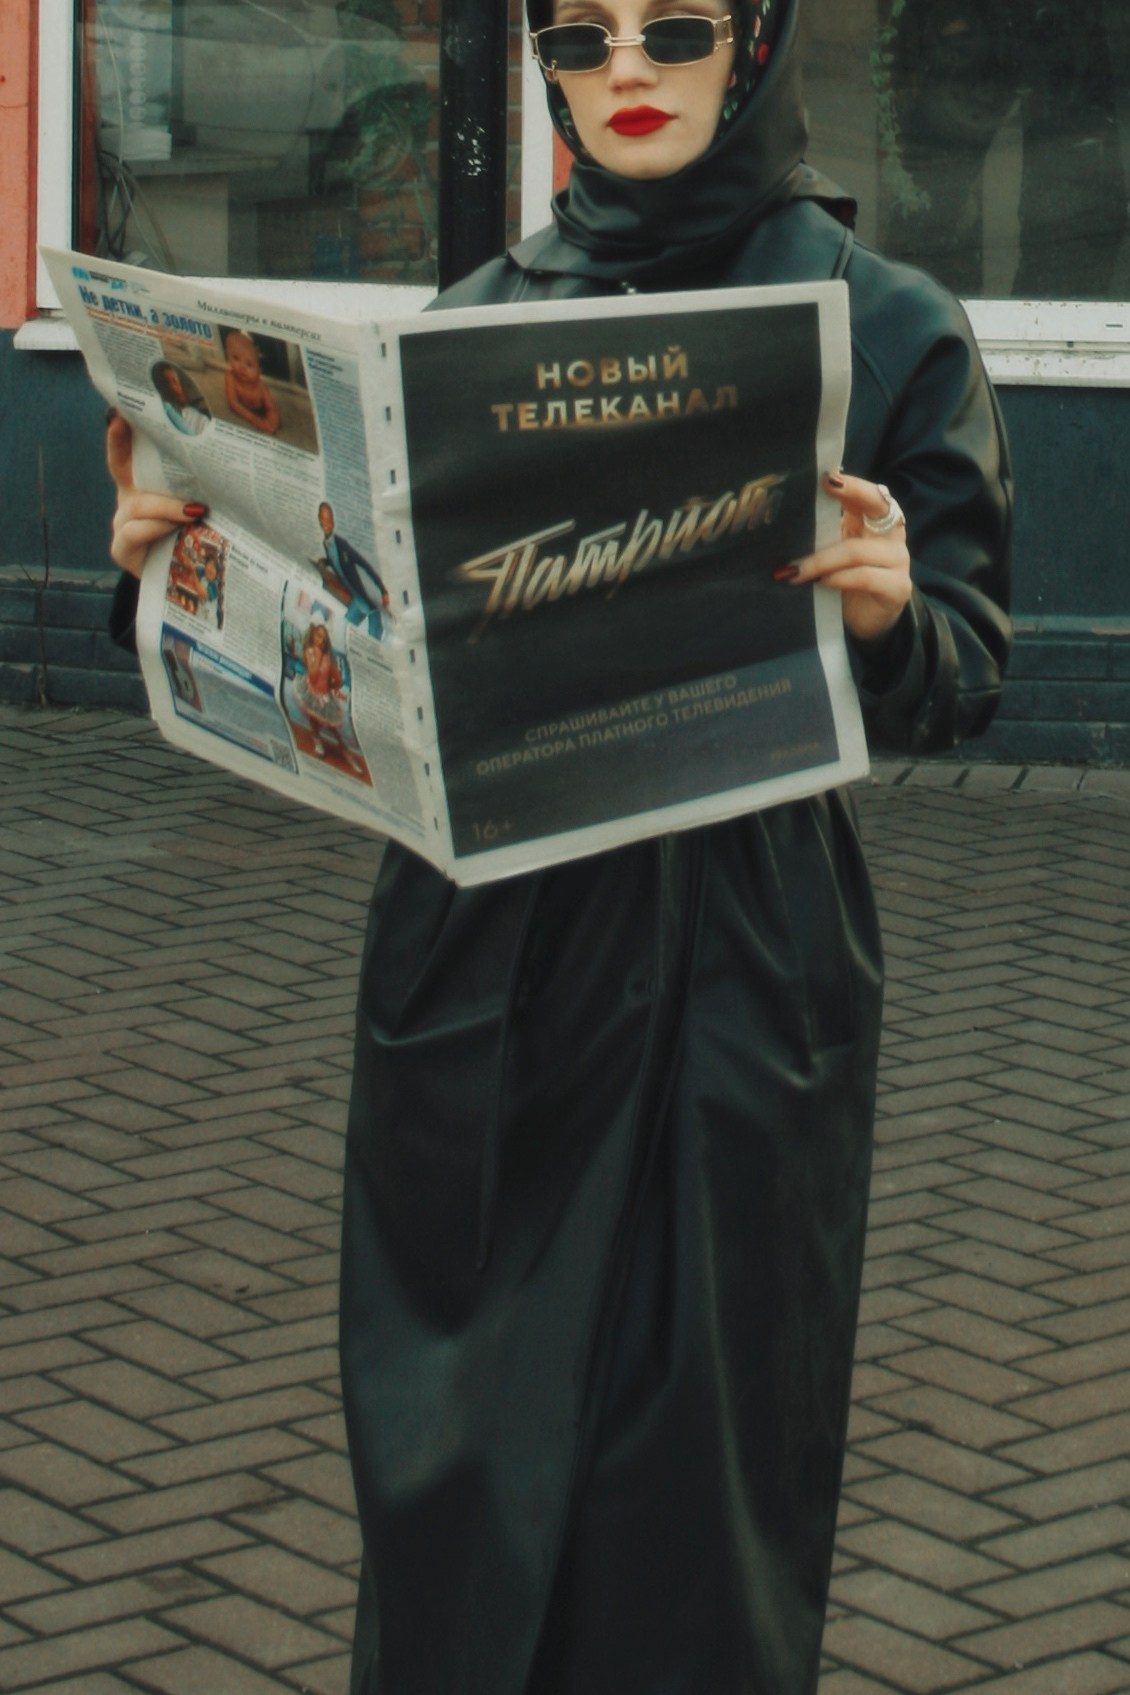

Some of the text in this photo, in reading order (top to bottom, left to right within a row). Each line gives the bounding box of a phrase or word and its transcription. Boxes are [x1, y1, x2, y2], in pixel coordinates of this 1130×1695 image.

[78, 284, 99, 306] Не
[149, 308, 160, 325] а
[162, 311, 213, 340] золото
[536, 344, 689, 390] НОВЫЙ
[490, 384, 738, 432] ТЕЛЕКАНАЛ
[454, 471, 793, 645] Патриот
[475, 677, 793, 776] ОПЕРАТОРА ПЛАТНОГО ТЕЛЕВИДЕНИЯ
[524, 673, 737, 743] СПРАШИВАЙТЕ У ВАШЕГО
[471, 817, 515, 842] 16+
